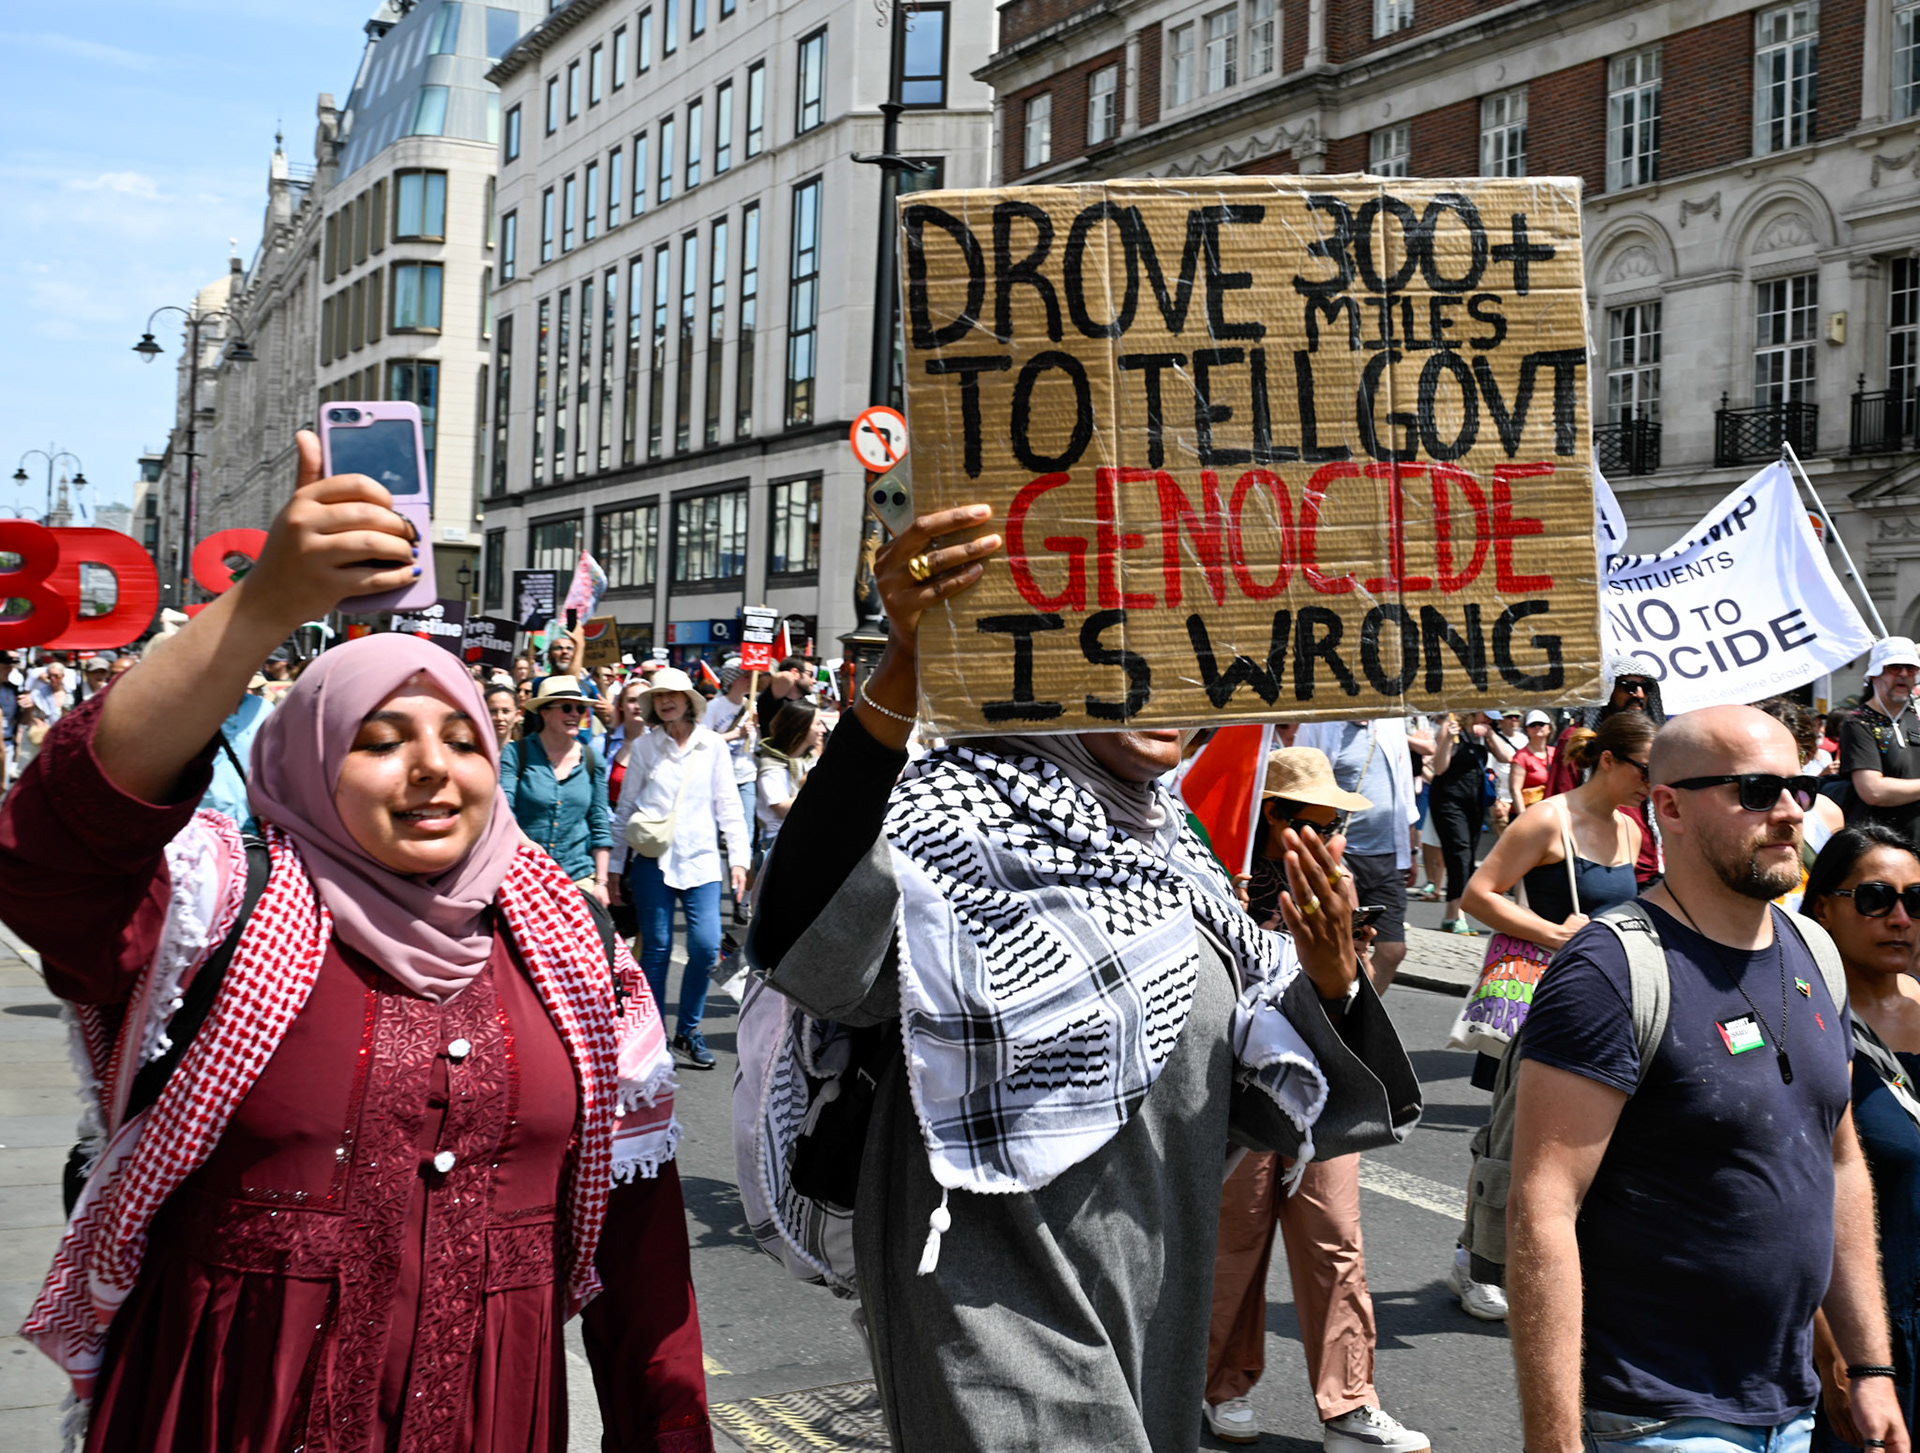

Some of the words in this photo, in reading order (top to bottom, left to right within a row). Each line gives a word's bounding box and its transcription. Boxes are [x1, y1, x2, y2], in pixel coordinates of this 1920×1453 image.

[902, 200, 1266, 350] DROVE
[1293, 193, 1556, 297] 300+
[1304, 293, 1508, 352] MILES
[925, 350, 1095, 479] TO
[1118, 347, 1354, 469] TELL
[1355, 347, 1587, 462] GOVT
[1005, 461, 1556, 612] GENOCIDE
[1606, 551, 1734, 597] STITUENTS
[976, 608, 1151, 722] IS
[1186, 599, 1565, 708] WRONG
[1608, 598, 1680, 643] NO
[1690, 598, 1742, 632] TO
[1615, 608, 1817, 682] OCIDE
